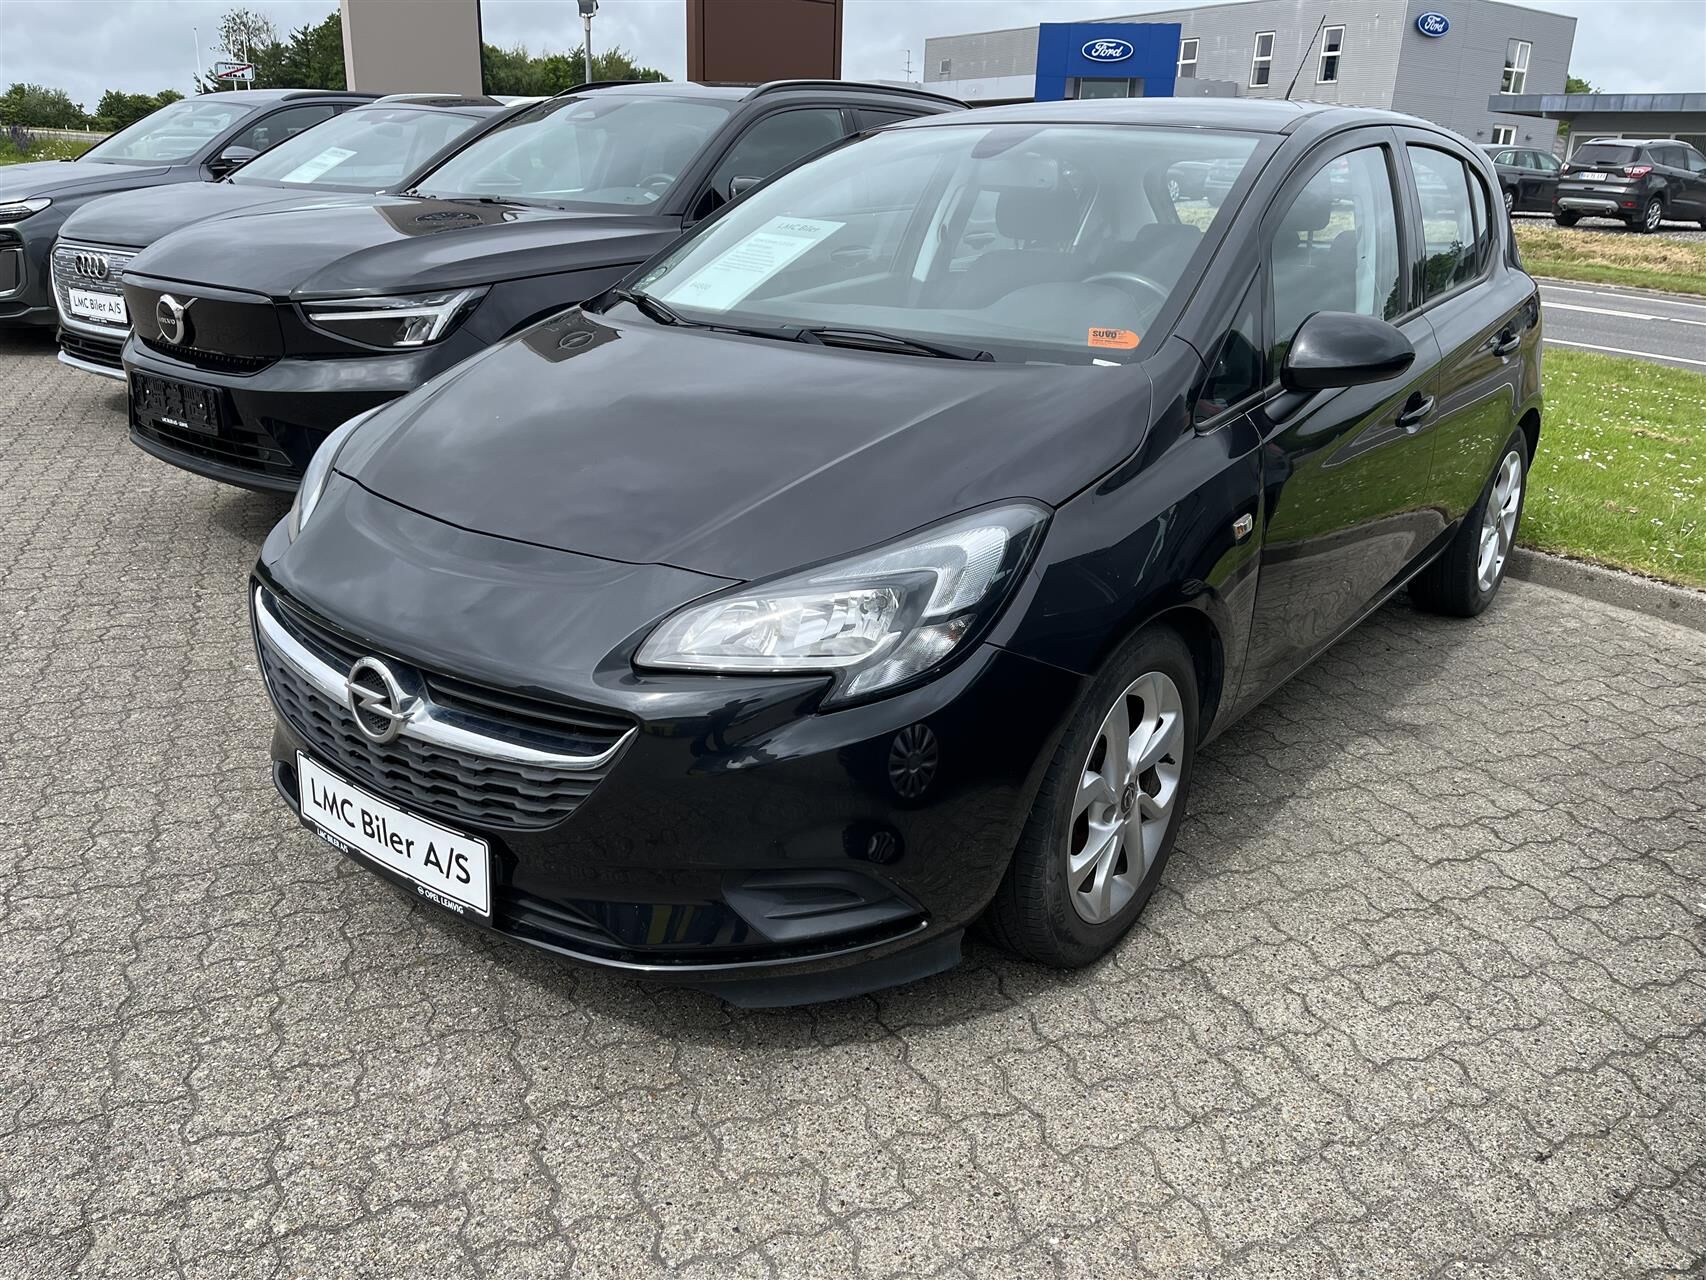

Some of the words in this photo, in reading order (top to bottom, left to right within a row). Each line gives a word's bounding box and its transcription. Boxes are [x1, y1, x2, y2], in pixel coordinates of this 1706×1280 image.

[1424, 15, 1444, 32] Ford
[1091, 42, 1123, 57] Ford
[73, 296, 89, 308] LMC
[89, 298, 106, 312] Biler
[108, 302, 122, 315] A/S
[311, 777, 356, 828] LMC
[360, 808, 415, 859] Biler
[423, 841, 471, 885] A/S
[424, 889, 441, 904] OPEL
[440, 896, 464, 914] LEMVIG
